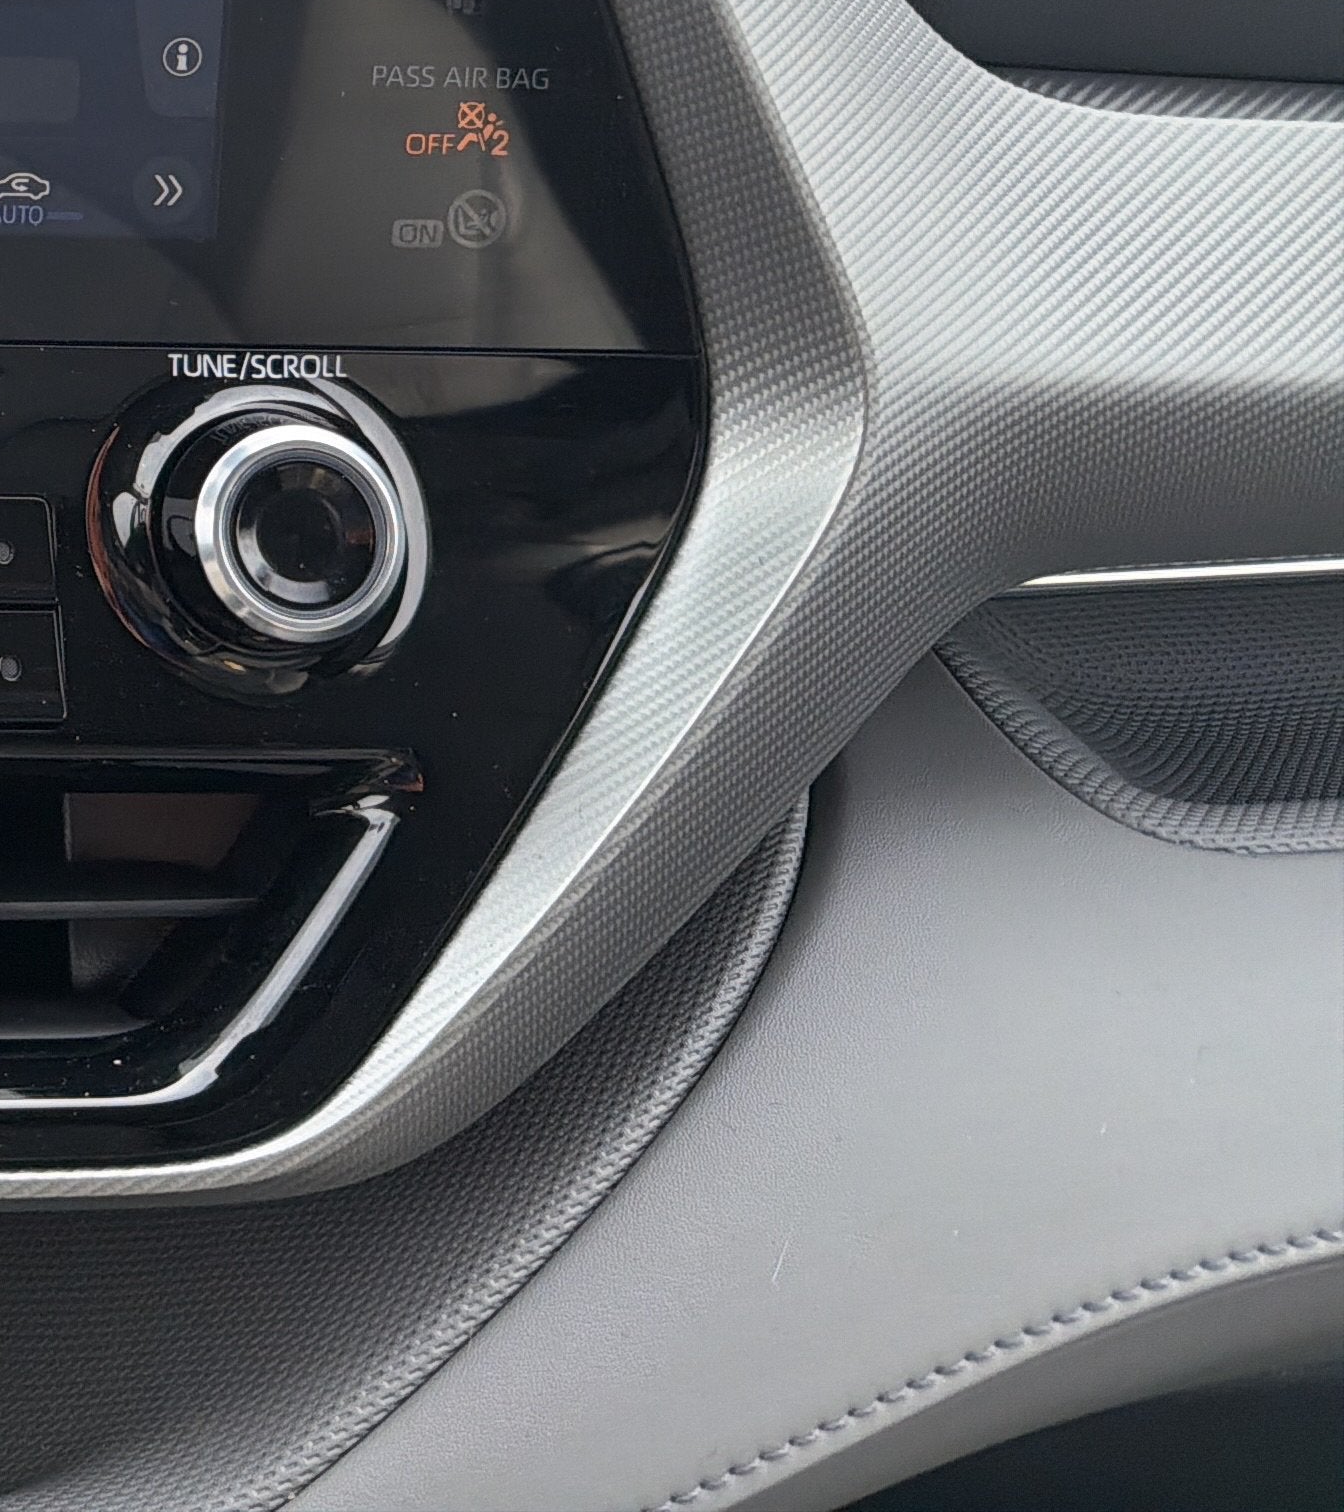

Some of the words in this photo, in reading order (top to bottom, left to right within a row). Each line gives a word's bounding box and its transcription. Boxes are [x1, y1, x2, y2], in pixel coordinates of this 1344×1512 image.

[372, 65, 435, 88] PASS
[444, 65, 487, 89] AIR
[495, 67, 549, 90] BAG
[406, 133, 456, 156] OFF
[168, 352, 348, 381] TUNE/SCROLL
